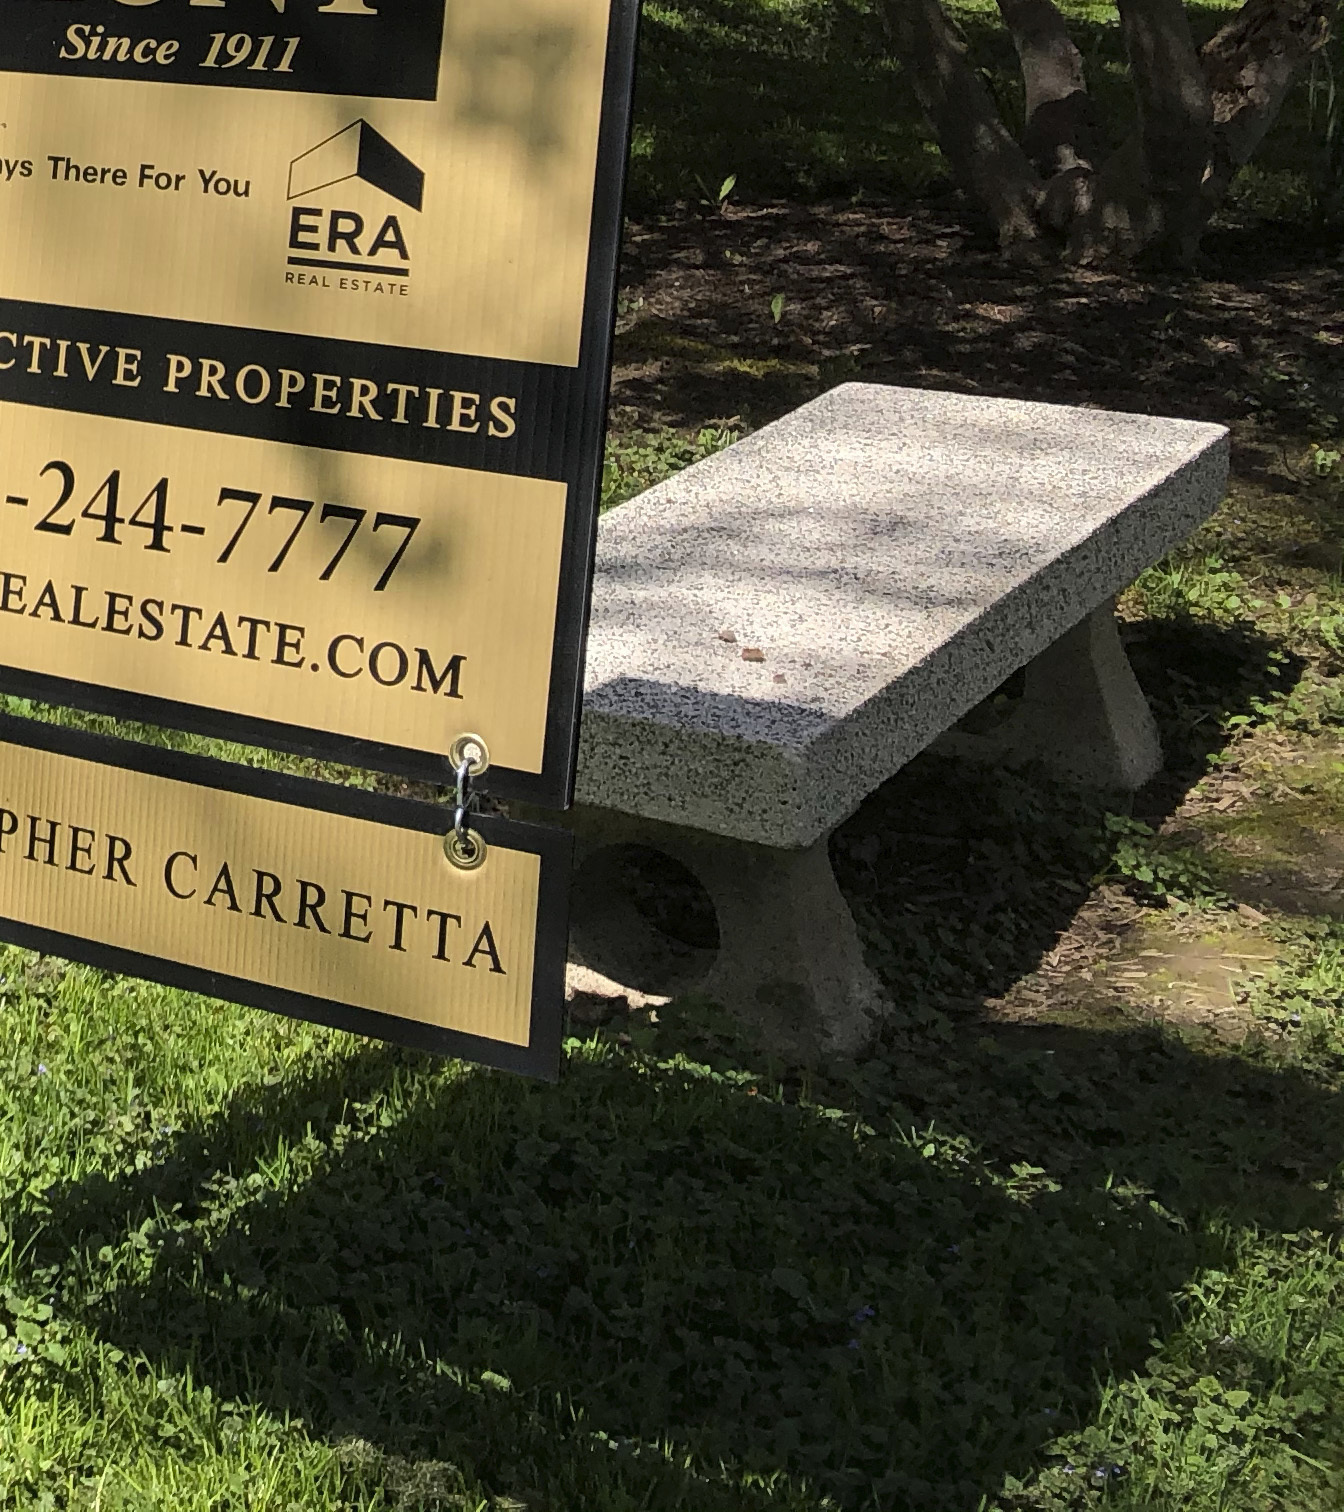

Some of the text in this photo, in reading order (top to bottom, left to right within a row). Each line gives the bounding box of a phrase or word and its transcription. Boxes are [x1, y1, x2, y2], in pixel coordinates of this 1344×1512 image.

[59, 22, 300, 74] Since 1911
[47, 155, 128, 187] There
[138, 163, 186, 191] For
[198, 168, 252, 198] You
[287, 206, 410, 262] ERA
[285, 271, 409, 298] REAL ESTATE
[164, 355, 517, 439] PROPERTIES
[164, 850, 508, 976] CARRETTA
